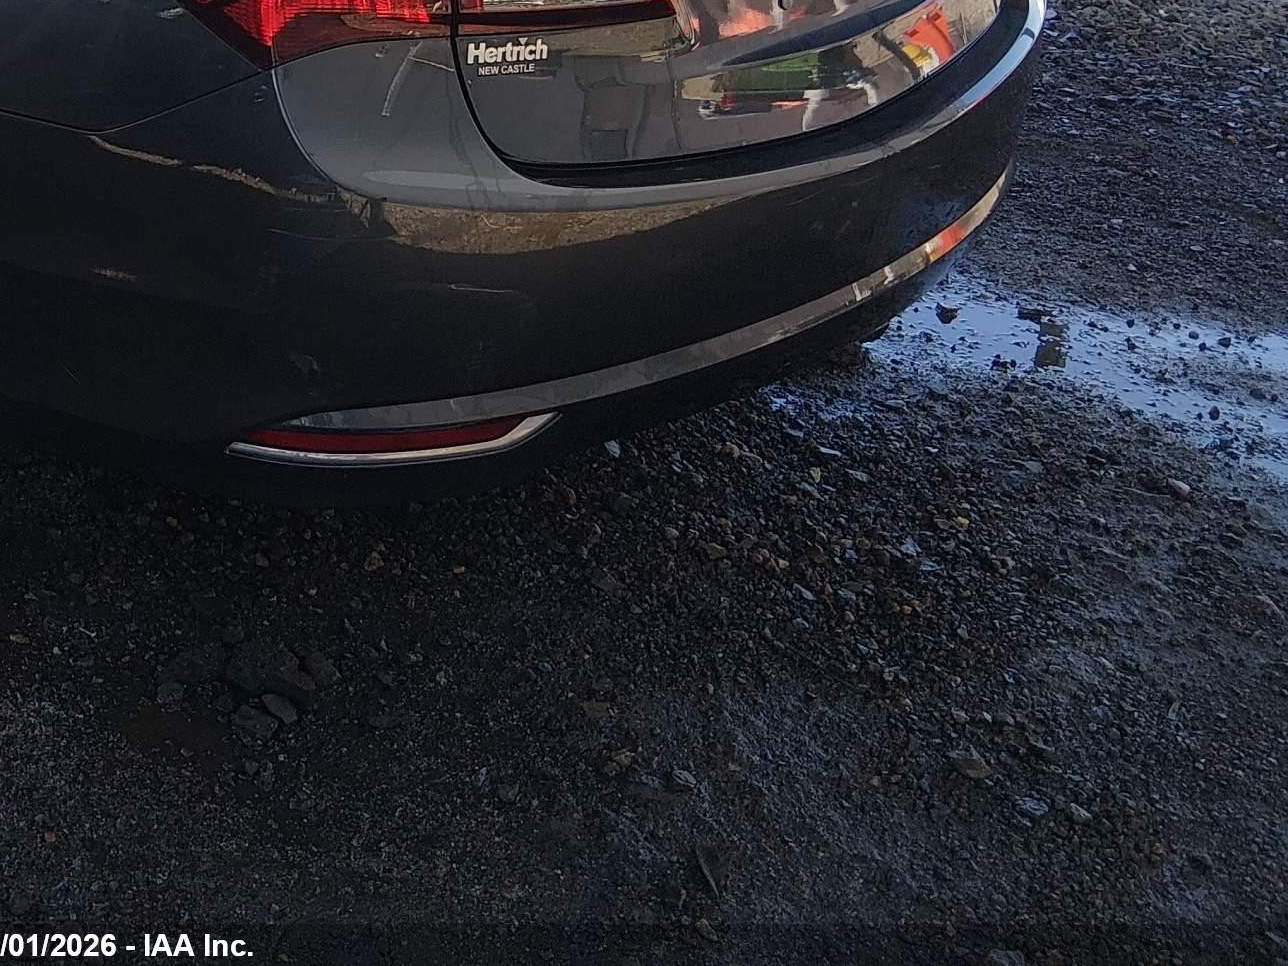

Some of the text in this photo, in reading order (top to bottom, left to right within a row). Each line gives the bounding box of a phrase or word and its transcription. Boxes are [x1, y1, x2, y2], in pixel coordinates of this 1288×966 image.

[467, 38, 548, 65] Hertrich
[478, 63, 535, 76] NEW CASTLE
